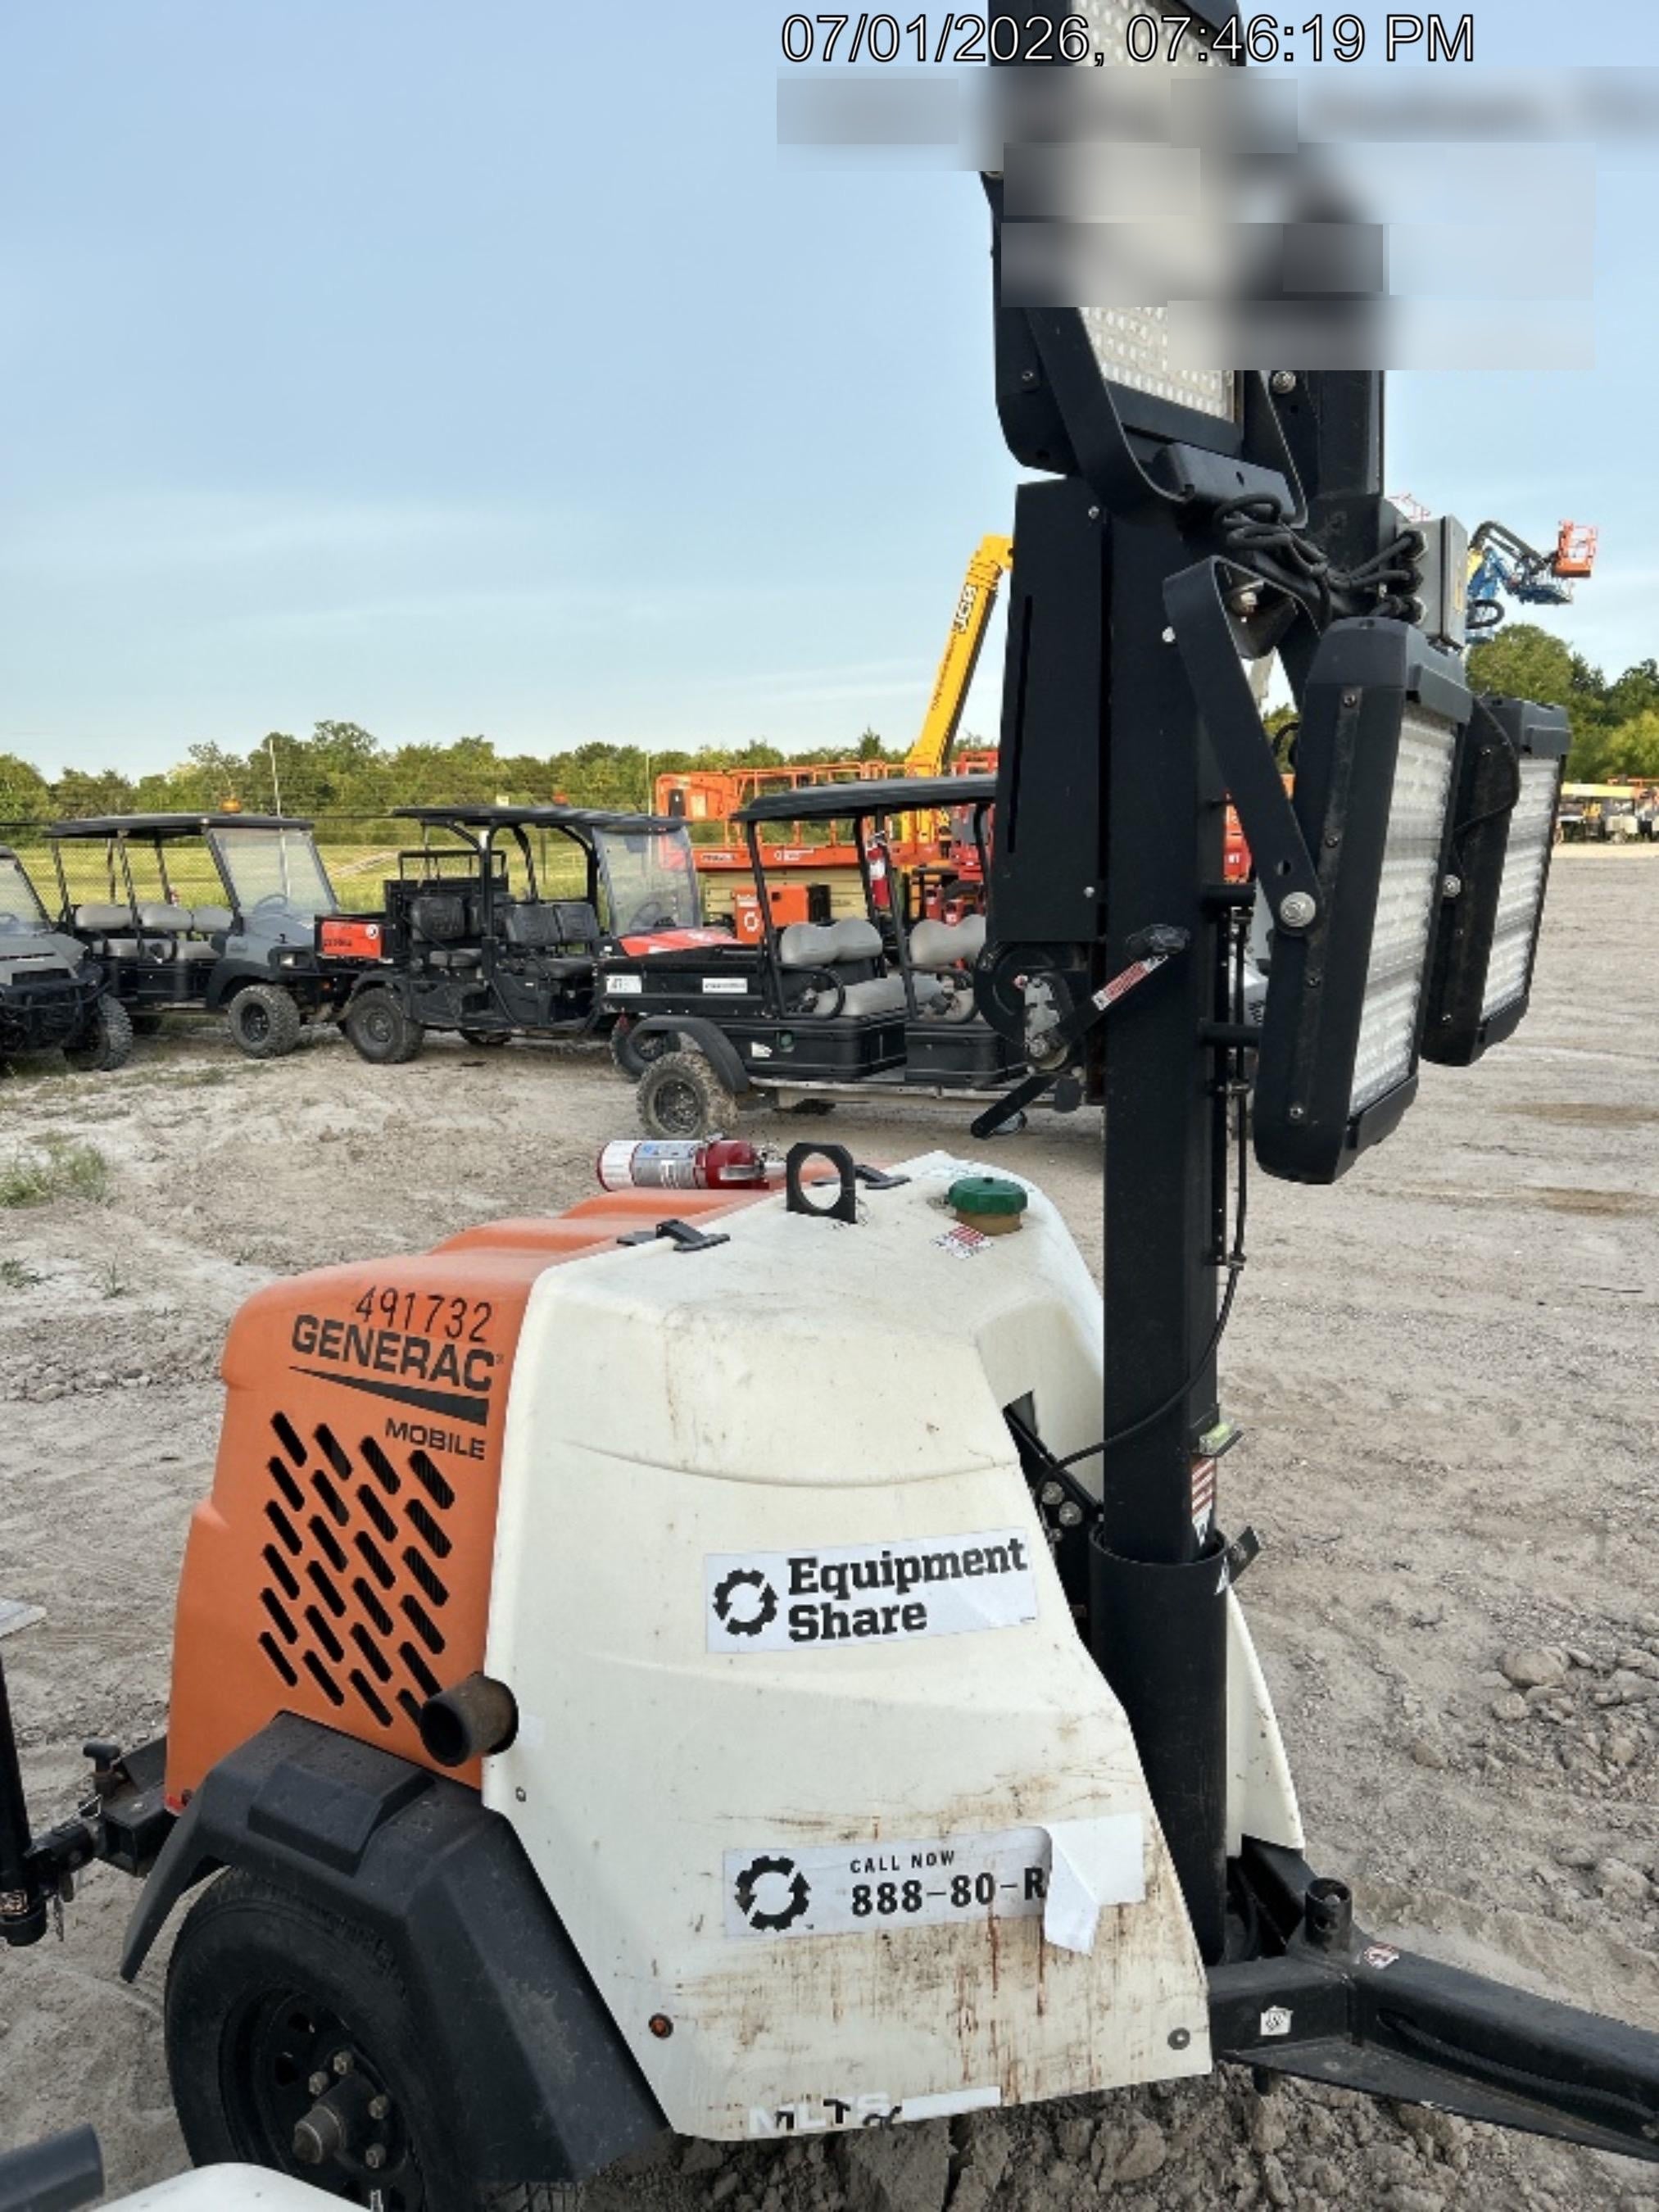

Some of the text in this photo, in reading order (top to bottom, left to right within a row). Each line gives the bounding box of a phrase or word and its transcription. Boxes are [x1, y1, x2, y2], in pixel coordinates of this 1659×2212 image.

[356, 1285, 492, 1342] 491732
[292, 1314, 494, 1391] GENERAC
[384, 1418, 486, 1461] MOBILE
[788, 1539, 1027, 1601] Equipment
[788, 1602, 927, 1642] Share
[850, 1850, 954, 1874] CALL NOW
